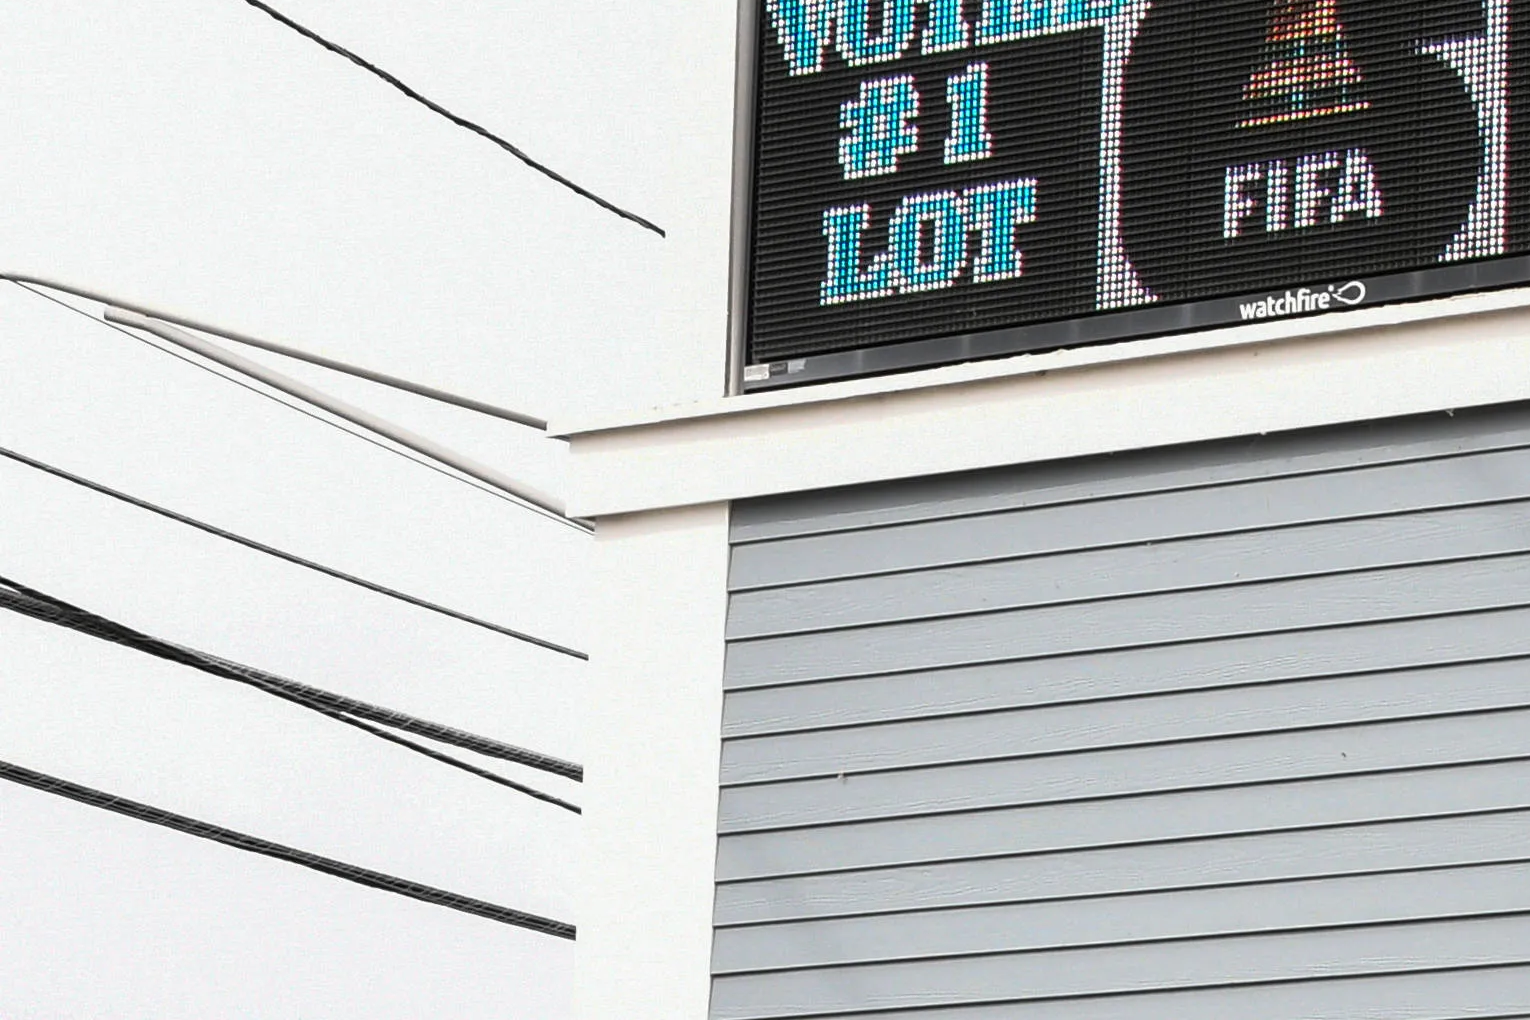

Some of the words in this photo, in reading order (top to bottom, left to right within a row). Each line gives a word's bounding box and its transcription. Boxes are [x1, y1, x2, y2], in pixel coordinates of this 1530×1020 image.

[1223, 148, 1383, 239] FIFA
[820, 177, 1038, 306] LOT
[1239, 288, 1332, 321] watchfire
